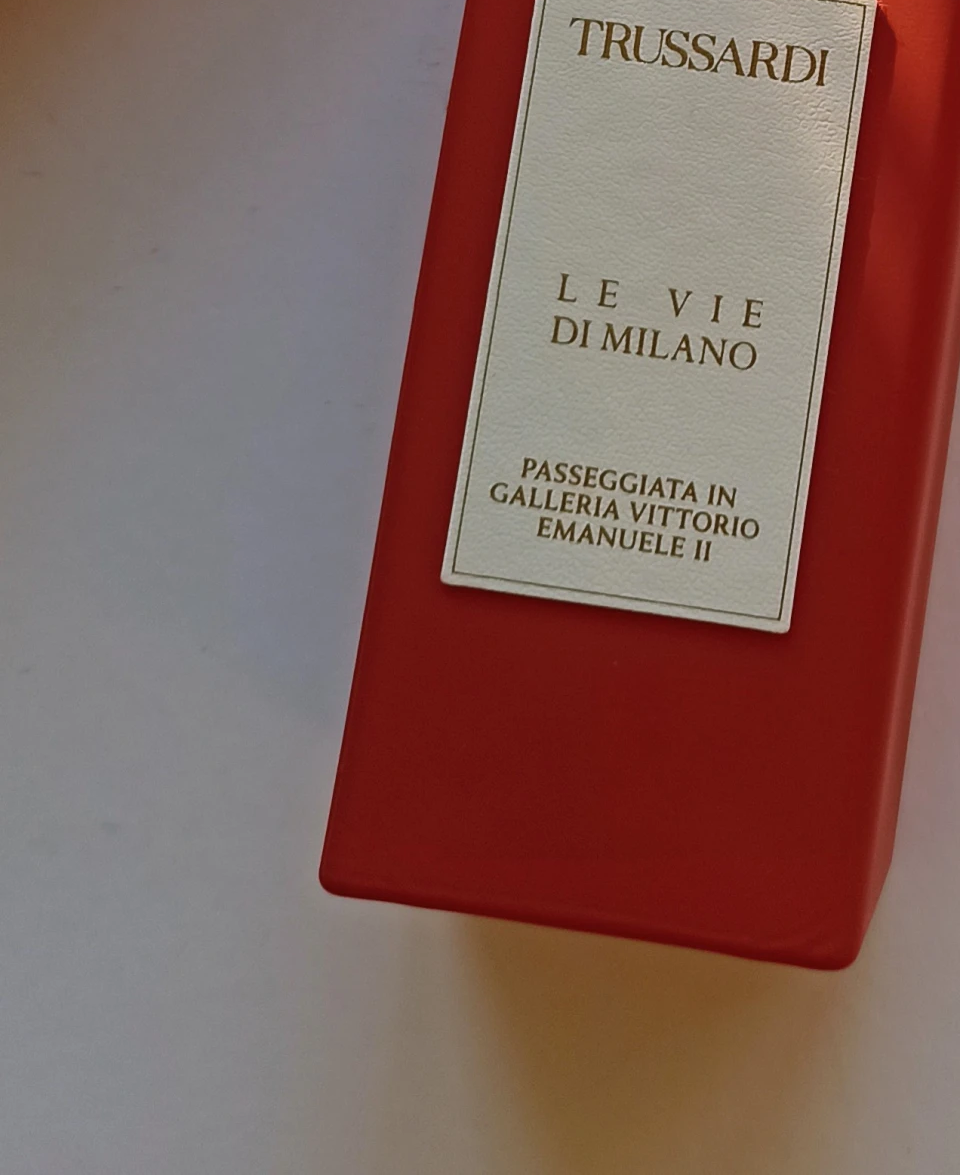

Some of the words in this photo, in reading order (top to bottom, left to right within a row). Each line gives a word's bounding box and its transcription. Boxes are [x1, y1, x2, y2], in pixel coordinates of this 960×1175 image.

[569, 17, 829, 87] TRUSSARDI
[557, 273, 620, 308] LE
[668, 288, 764, 328] VIE
[551, 315, 592, 348] DI
[601, 323, 757, 370] MILANO
[521, 457, 698, 503] PASSEGGIATA
[707, 484, 737, 509] IN
[490, 482, 620, 521] GALLERIA
[630, 501, 760, 540] VITTORIO
[536, 517, 686, 559] EMANUELE
[694, 539, 712, 562] II
